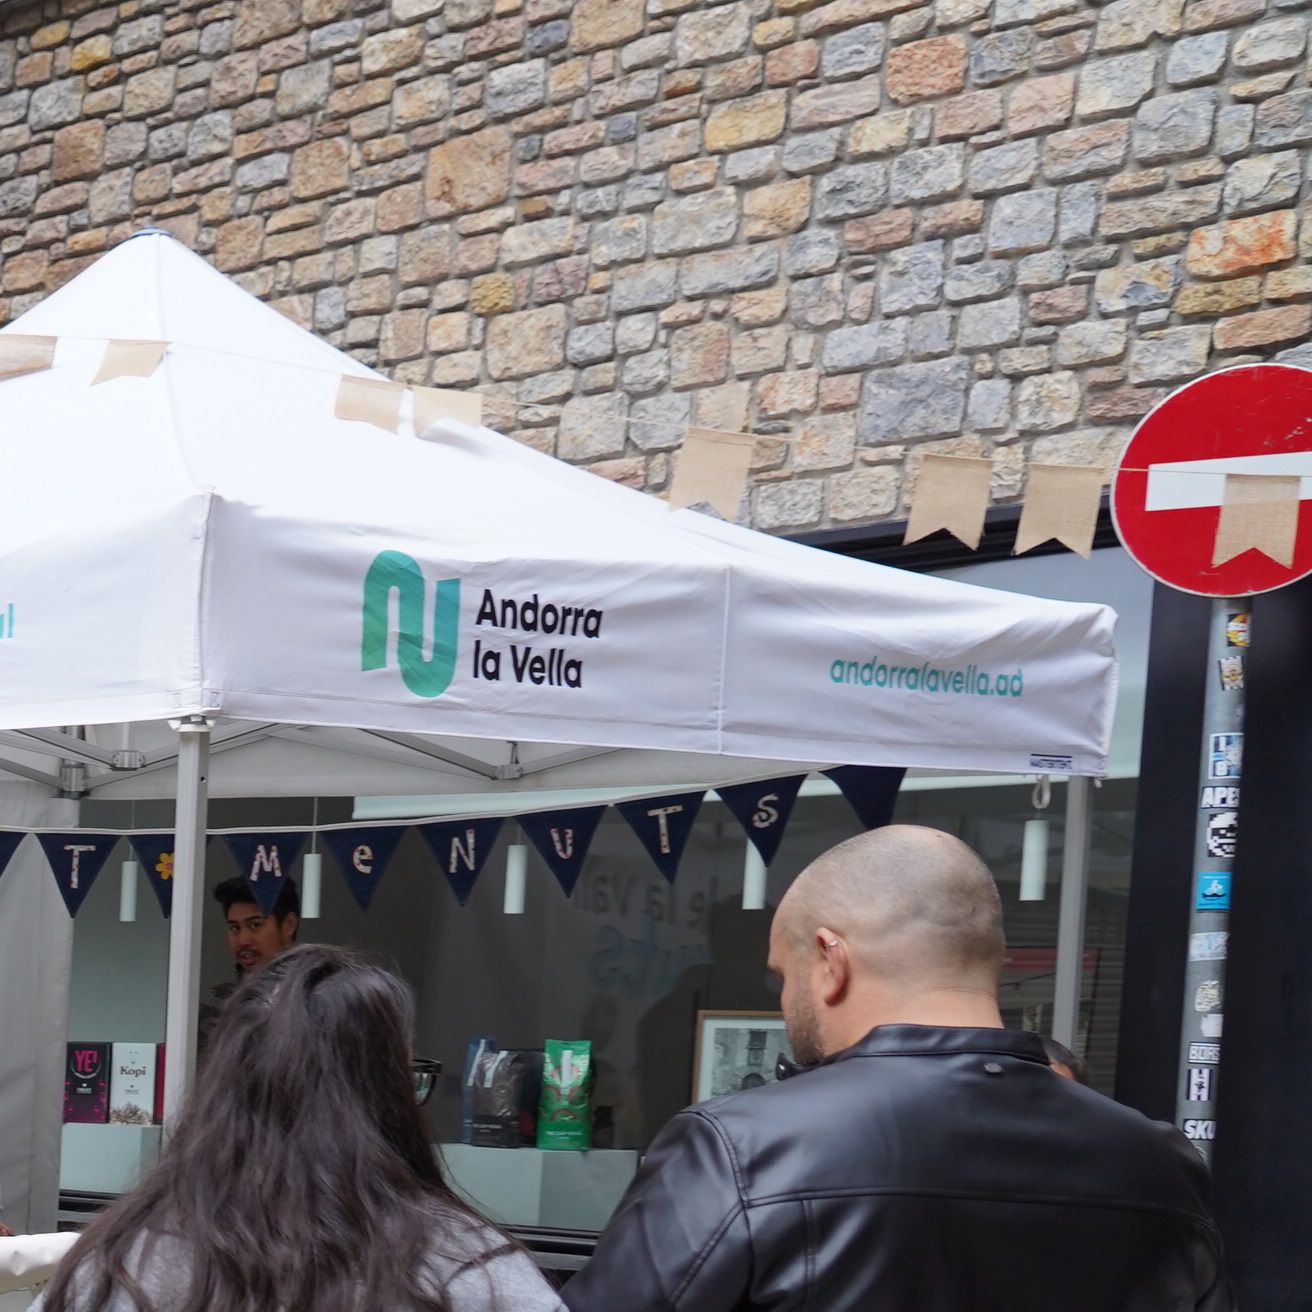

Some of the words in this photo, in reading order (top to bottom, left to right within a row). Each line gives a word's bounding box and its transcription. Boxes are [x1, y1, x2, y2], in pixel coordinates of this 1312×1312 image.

[476, 588, 603, 639] Andorra
[473, 639, 501, 682] la
[510, 645, 584, 689] Vella
[830, 655, 1023, 697] andorralavella.ad
[120, 1066, 147, 1078] Kopi
